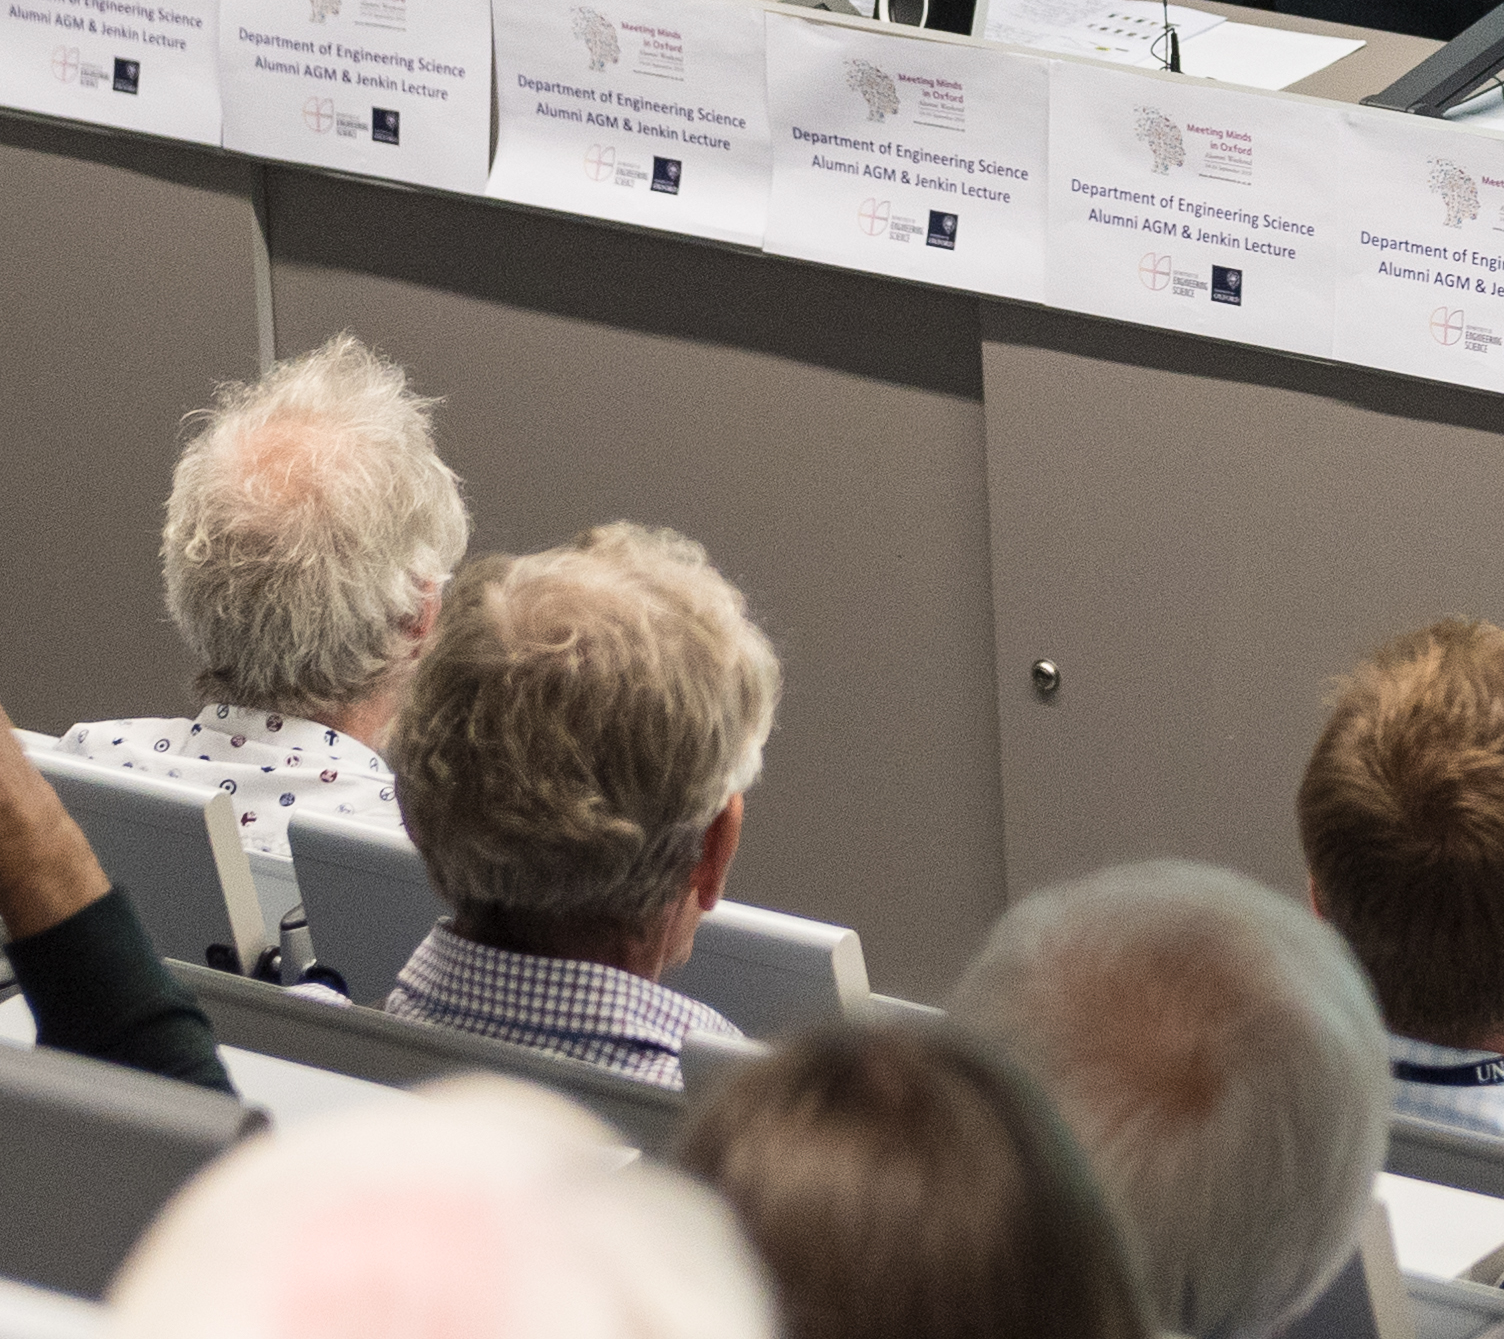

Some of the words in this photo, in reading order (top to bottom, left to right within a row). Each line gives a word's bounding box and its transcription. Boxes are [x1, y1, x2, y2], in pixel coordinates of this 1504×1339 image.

[9, 4, 51, 25] Alumni
[55, 13, 84, 30] AGM
[89, 21, 97, 33] &
[101, 23, 139, 42] Jenkin
[143, 30, 186, 50] Lecture
[158, 8, 203, 28] Science
[239, 26, 314, 53] Department
[319, 41, 332, 56] of
[336, 44, 414, 72] Engineering
[418, 57, 466, 78] Science
[255, 55, 300, 76] Alumni
[304, 65, 337, 81] AGM
[341, 69, 351, 84] &
[356, 72, 398, 91] Jenkin
[401, 79, 448, 101] Lecture
[898, 74, 934, 88] Meeting
[936, 79, 963, 91] Minds
[922, 88, 931, 98] in
[933, 90, 964, 103] Oxford
[518, 74, 596, 101] Department
[600, 90, 612, 105] of
[617, 93, 694, 121] Engineering
[698, 107, 746, 129] Science
[536, 102, 582, 122] Alumni
[586, 112, 619, 129] AGM
[623, 118, 633, 132] &
[637, 122, 678, 140] Jenkin
[683, 129, 731, 151] Lecture
[1187, 123, 1224, 140] Meeting
[1226, 130, 1252, 143] Minds
[1210, 140, 1219, 150] in
[1220, 142, 1253, 156] Oxford
[793, 126, 874, 153] Department
[879, 142, 892, 156] of
[896, 144, 975, 173] Engineering
[979, 158, 1029, 181] Science
[812, 154, 859, 175] Alumni
[863, 164, 896, 182] AGM
[901, 171, 911, 185] &
[915, 173, 957, 193] Jenkin
[962, 182, 1011, 204] Lecture
[1072, 179, 1155, 207] Department
[1160, 195, 1173, 209] of
[1178, 198, 1259, 229] Engineering
[1263, 214, 1315, 237] Science
[1088, 208, 1138, 230] Alumni
[1142, 219, 1177, 237] AGM
[1182, 225, 1192, 240] &
[1196, 228, 1240, 249] Jenkin
[1245, 237, 1296, 259] Lecture
[1360, 230, 1448, 260] Department
[1452, 249, 1467, 264] of
[1378, 261, 1430, 283] Alumni
[1434, 272, 1470, 291] AGM
[1475, 278, 1487, 294] &
